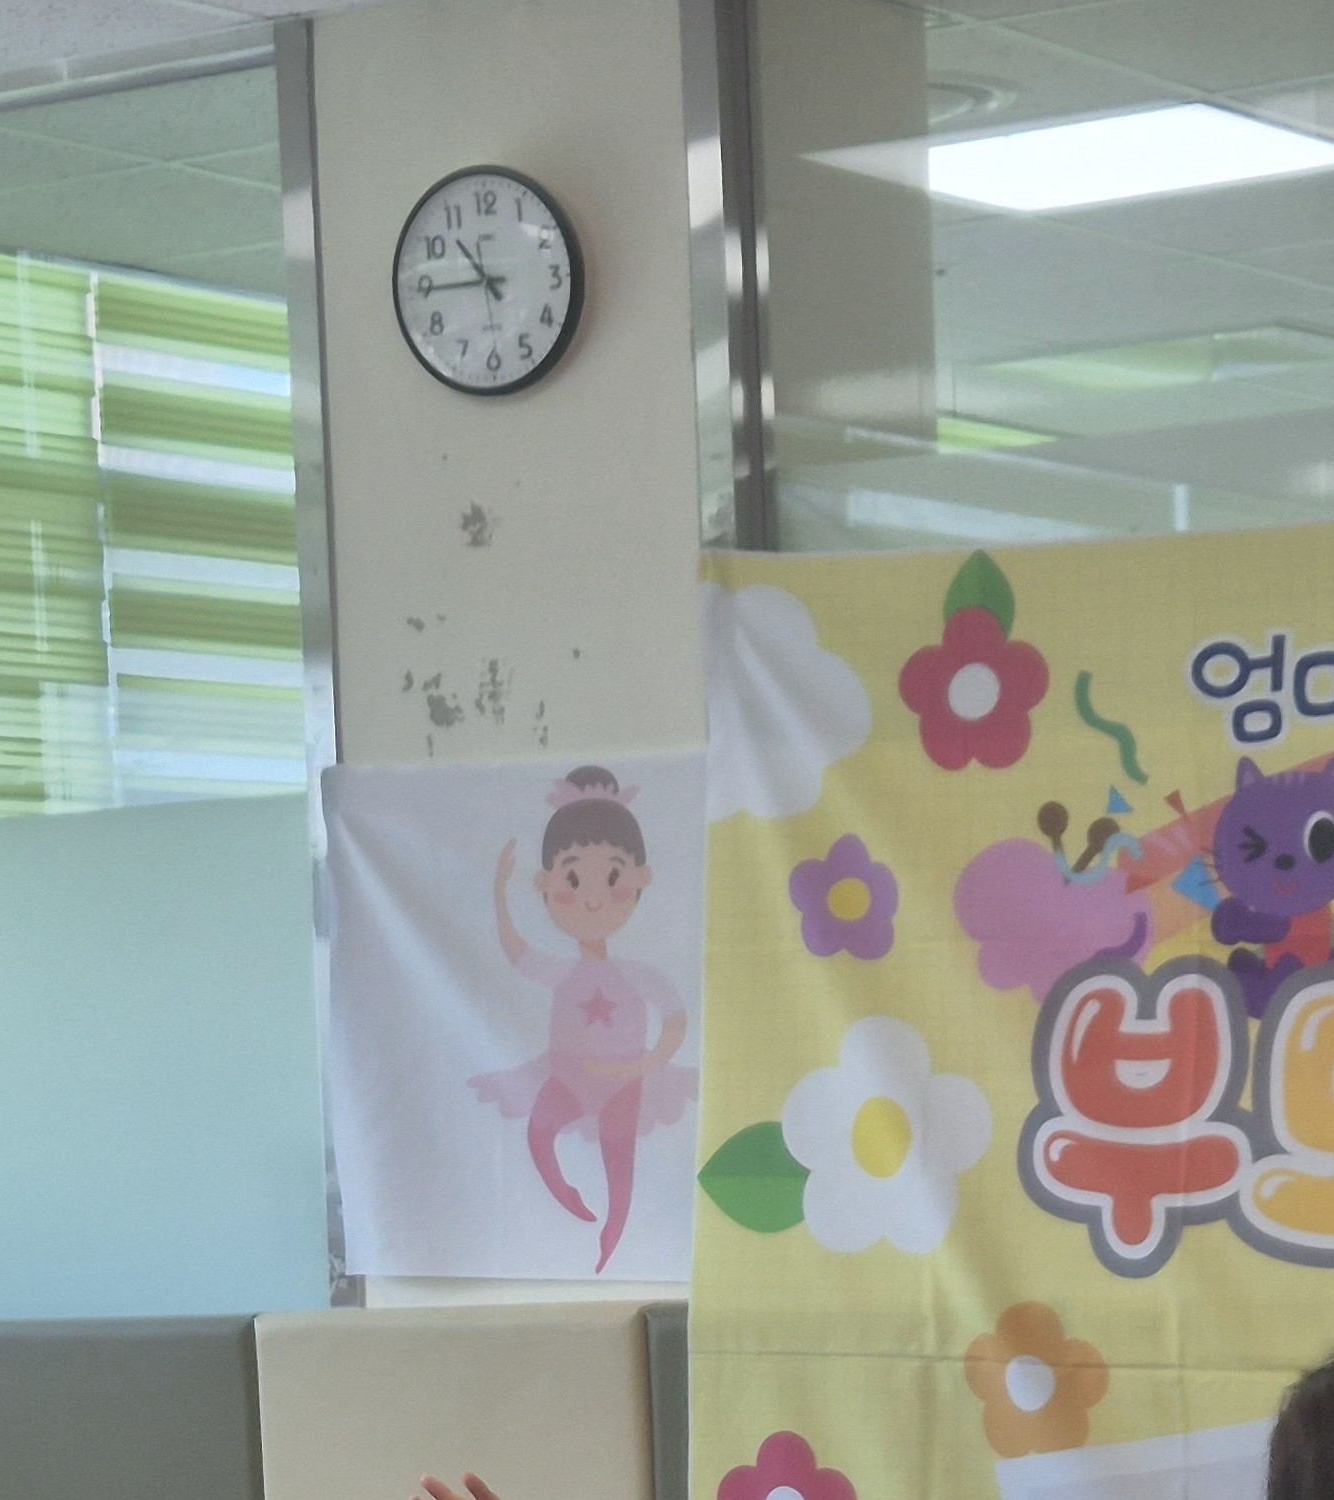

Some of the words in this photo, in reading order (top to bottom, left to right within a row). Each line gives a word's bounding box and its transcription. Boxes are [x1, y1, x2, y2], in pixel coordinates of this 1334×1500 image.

[473, 190, 497, 216] 12
[514, 197, 524, 224] 1
[444, 204, 462, 231] 11
[424, 235, 446, 260] 10
[417, 275, 432, 298] 9
[548, 264, 562, 290] 3
[430, 311, 445, 336] 8
[539, 303, 554, 328] 4
[455, 338, 469, 358] 7
[485, 346, 502, 371] 6
[518, 333, 533, 359] 5
